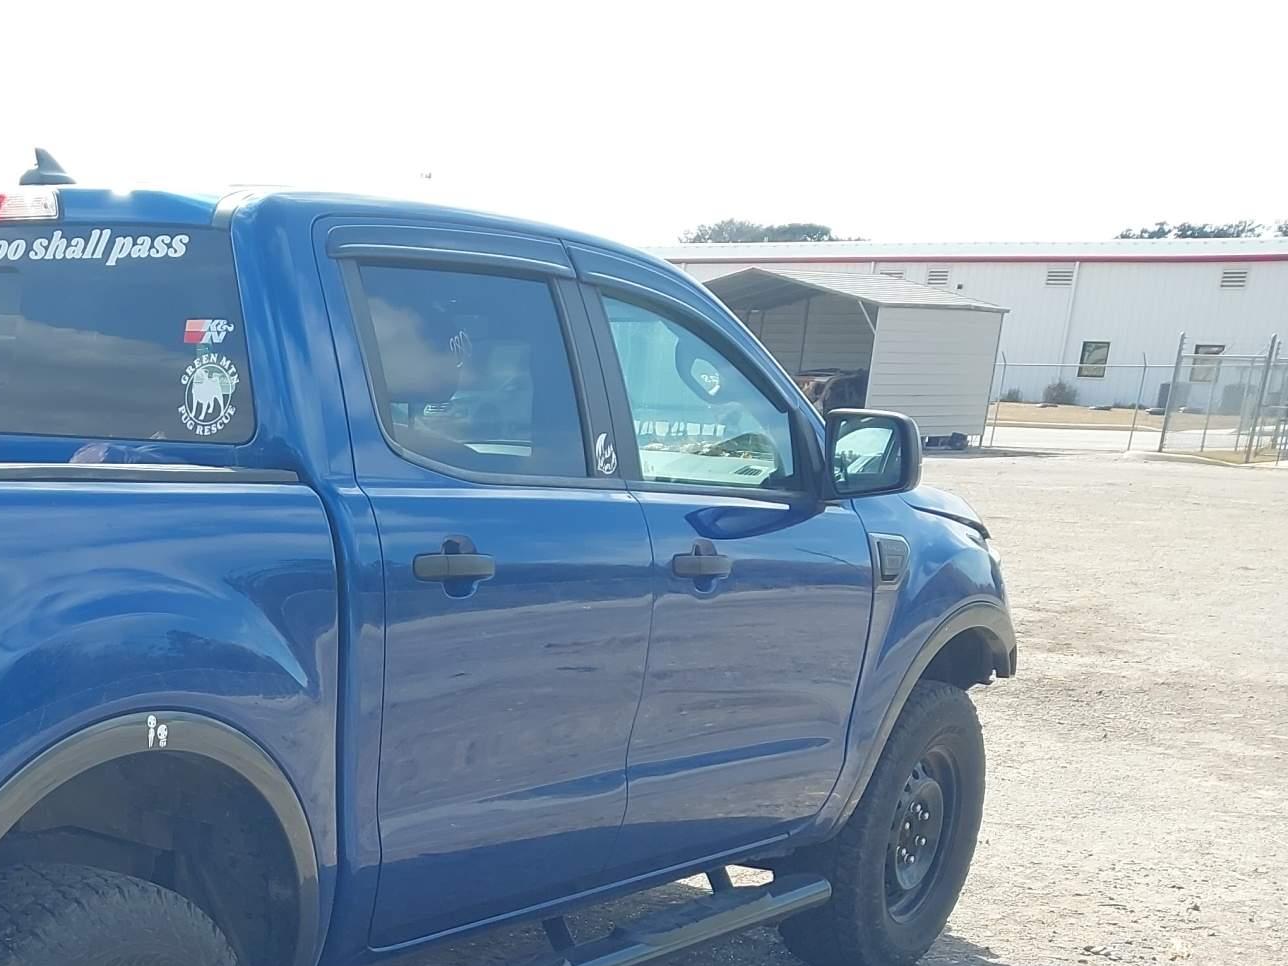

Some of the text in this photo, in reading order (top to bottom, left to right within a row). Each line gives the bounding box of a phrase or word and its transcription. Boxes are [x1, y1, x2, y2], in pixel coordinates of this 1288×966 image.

[29, 228, 111, 260] shall
[105, 234, 190, 266] pass
[181, 353, 240, 385] GREEN MTN
[178, 405, 236, 436] PUG RESCUE
